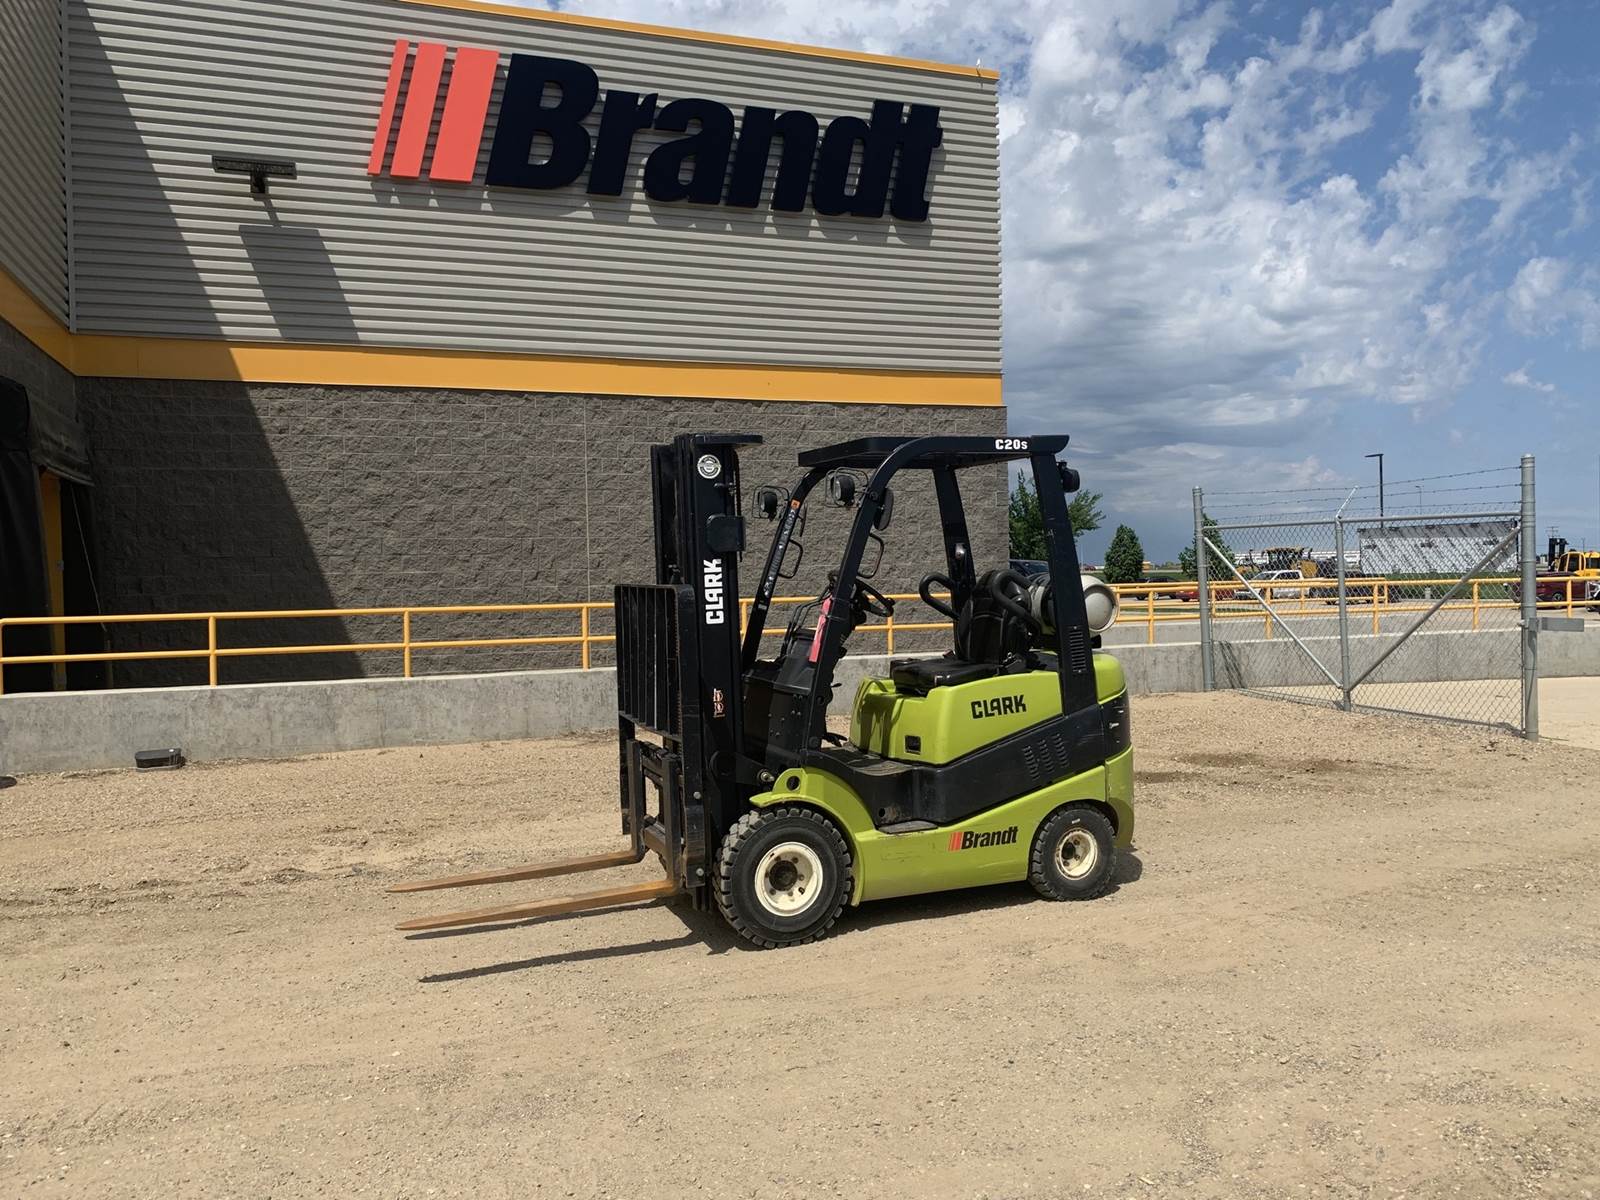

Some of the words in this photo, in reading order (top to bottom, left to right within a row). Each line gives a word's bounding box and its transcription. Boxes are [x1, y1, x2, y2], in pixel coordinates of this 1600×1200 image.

[485, 53, 943, 222] Brandt
[995, 439, 1028, 450] C20s
[703, 559, 724, 625] CLARK
[970, 695, 1027, 719] CLARK
[961, 826, 1018, 850] Brandt
